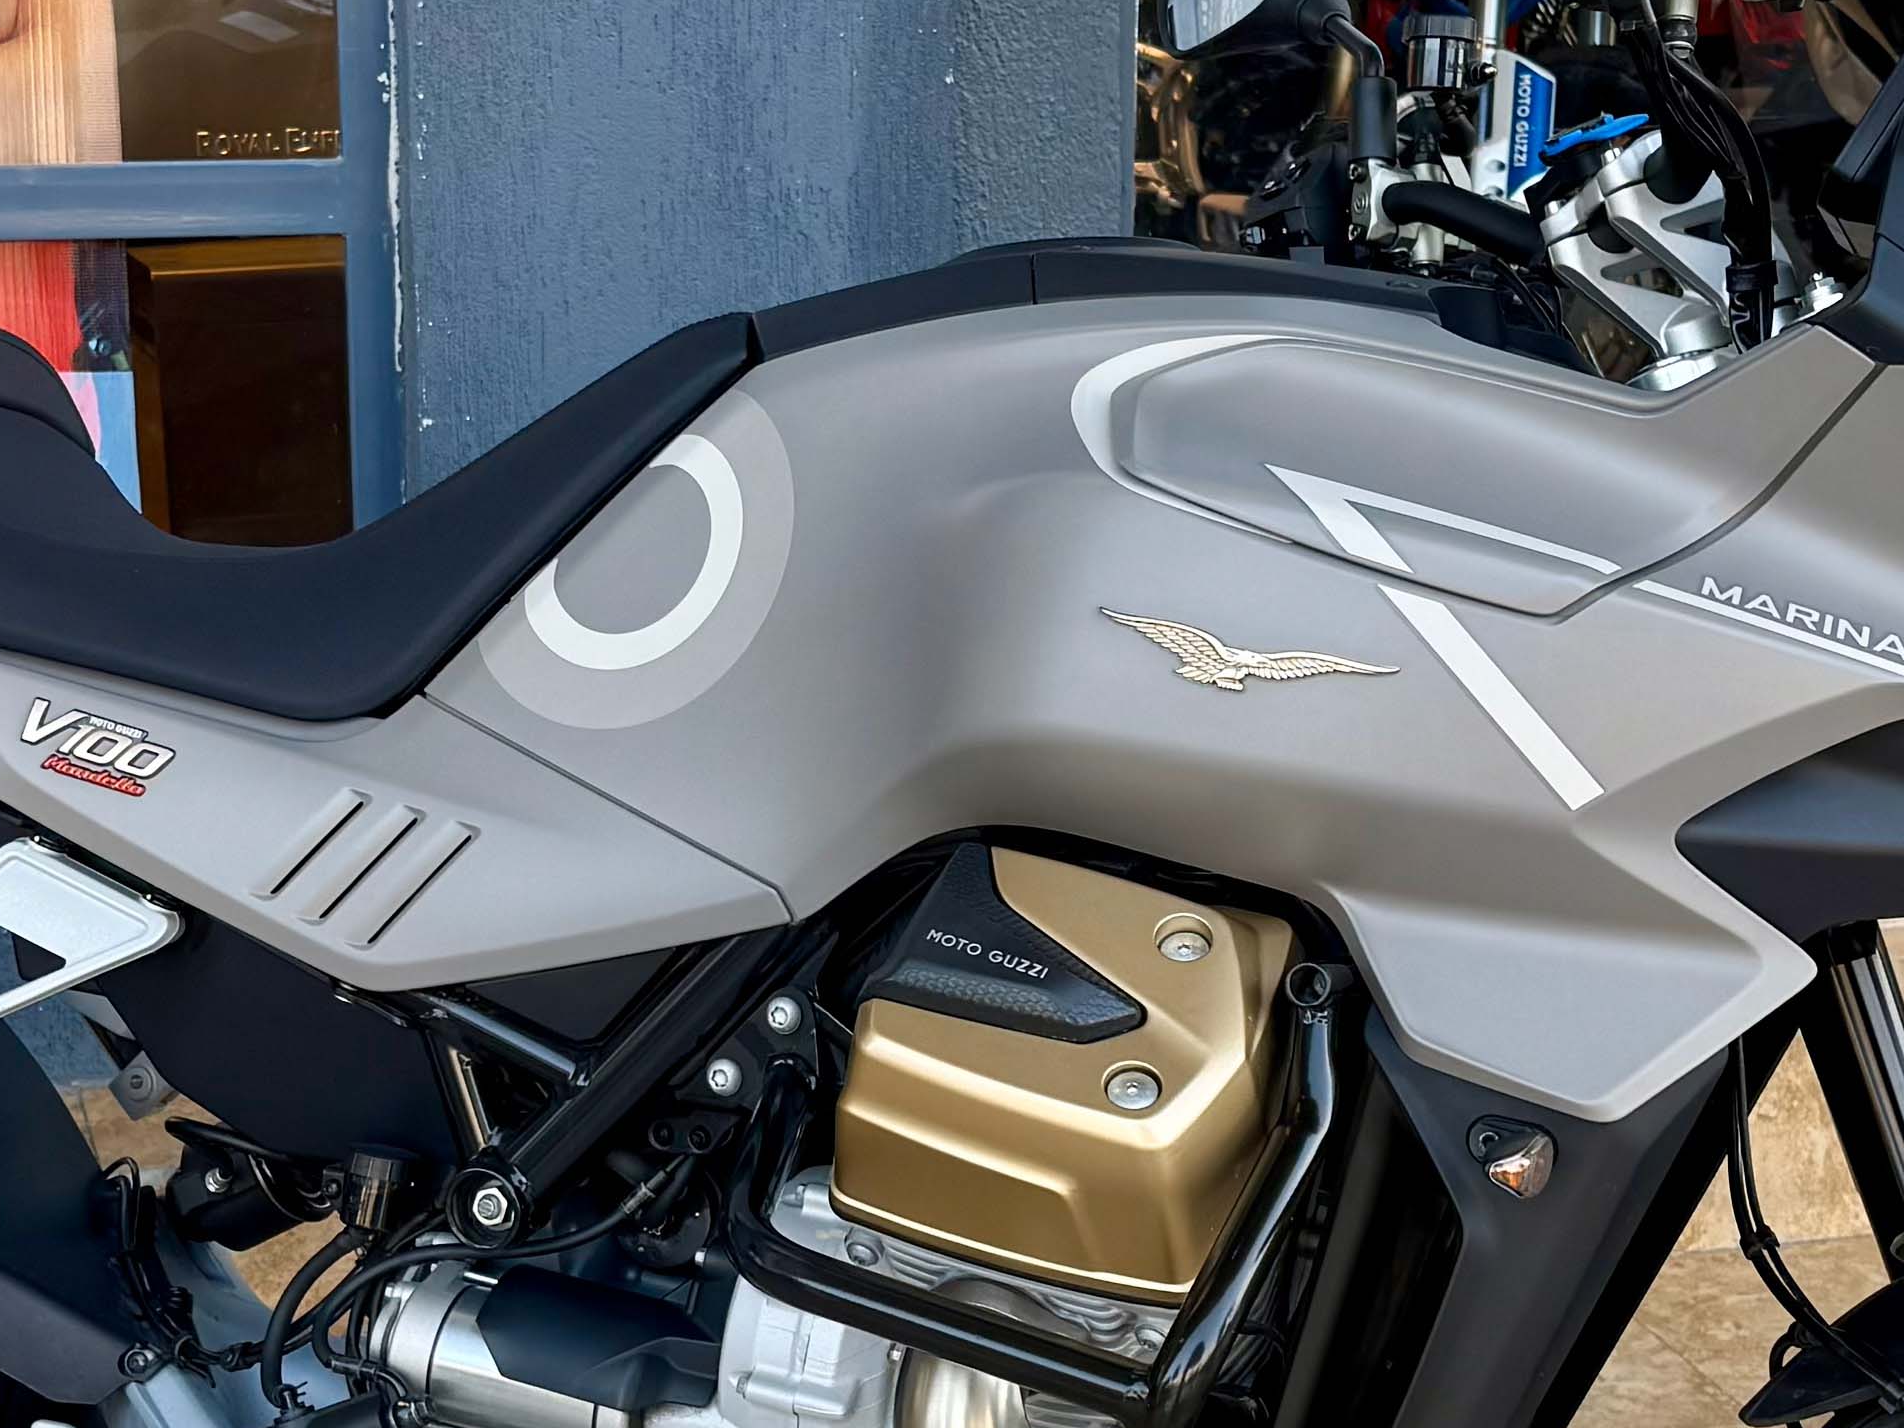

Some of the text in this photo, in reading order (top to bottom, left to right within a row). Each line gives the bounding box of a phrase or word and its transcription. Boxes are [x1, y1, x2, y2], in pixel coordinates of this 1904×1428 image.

[197, 131, 281, 157] ROYAL
[1513, 73, 1533, 168] MOTO GUZZI
[21, 697, 176, 780] V100
[89, 715, 143, 739] MOTO GUZZI
[926, 928, 1049, 980] MOTO GUZZI
